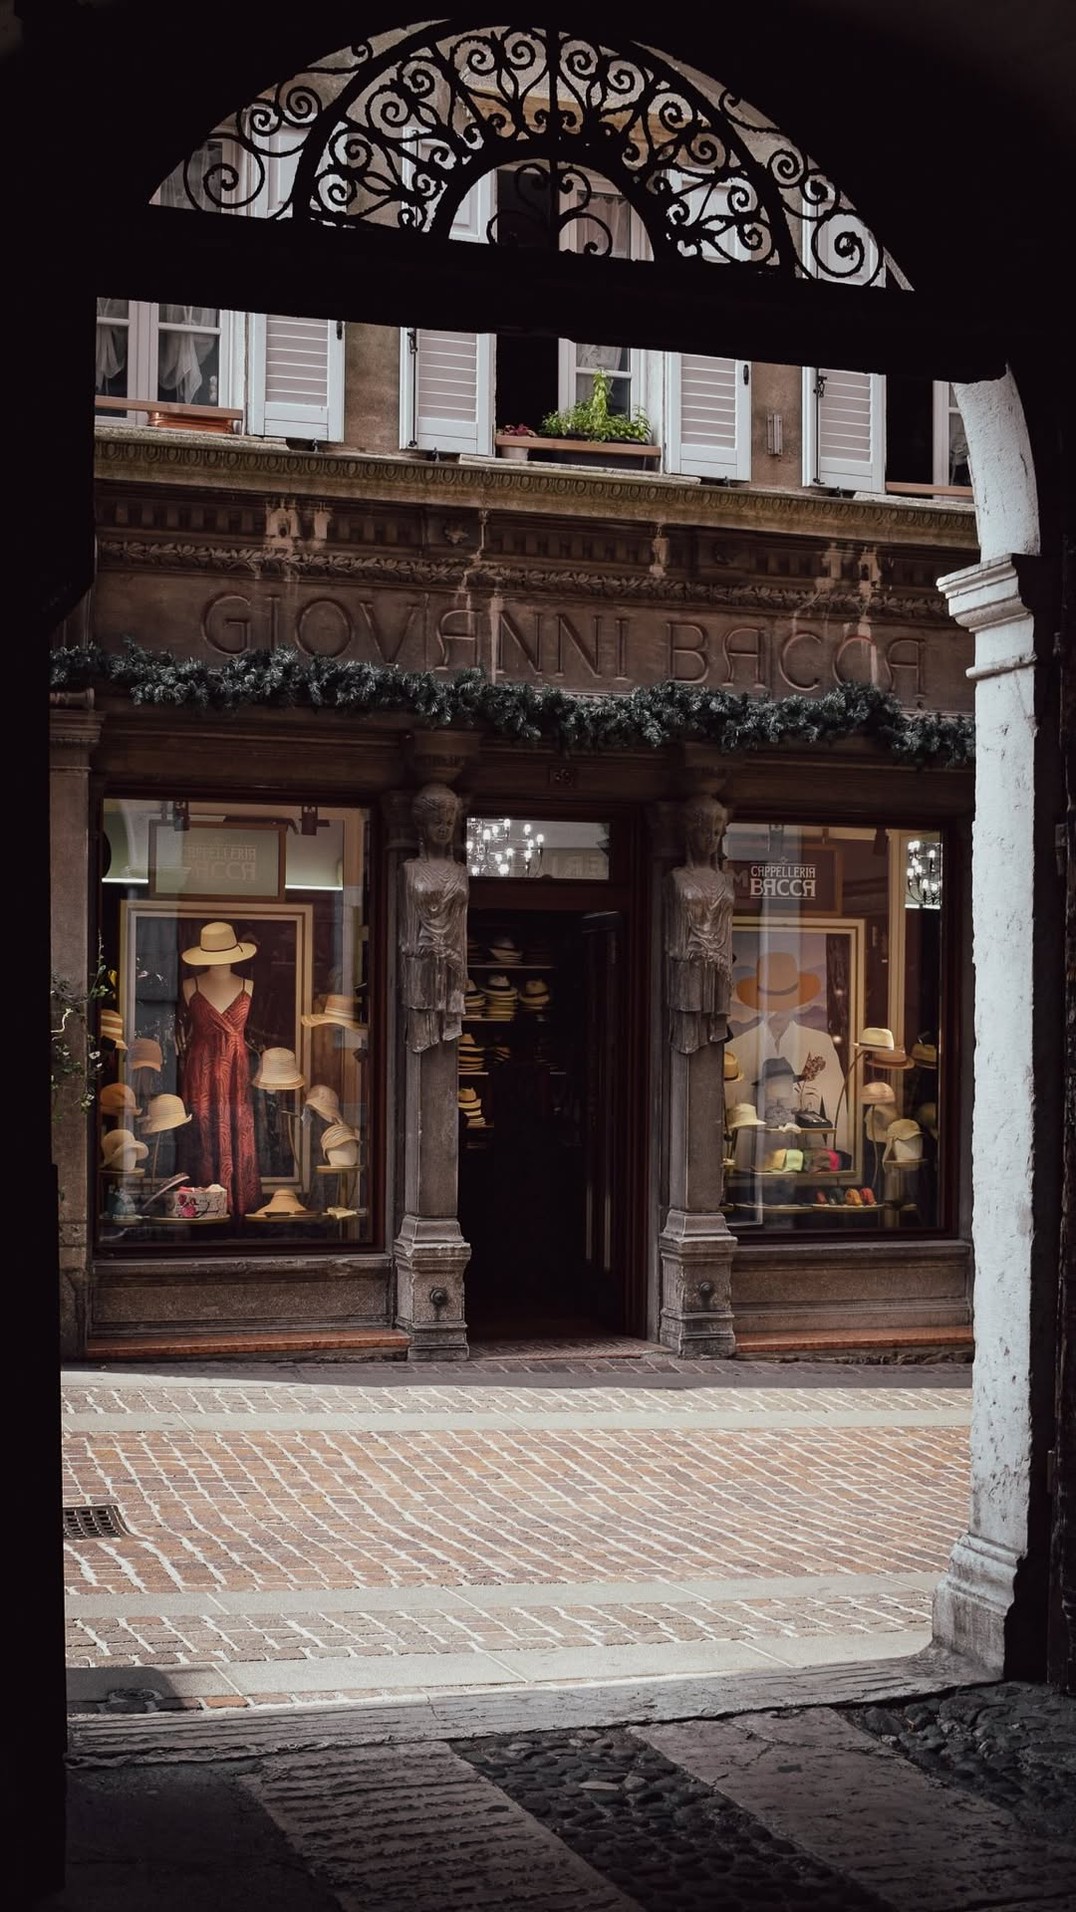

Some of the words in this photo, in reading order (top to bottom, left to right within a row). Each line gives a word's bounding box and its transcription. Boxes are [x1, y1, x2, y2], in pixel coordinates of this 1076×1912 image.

[201, 593, 630, 682] GIOVANNI
[666, 621, 925, 699] BACCA
[184, 847, 256, 860] APPELLERIA
[186, 861, 256, 880] ACCA
[751, 866, 816, 878] CAPPELLERIA
[750, 878, 816, 897] BACCA
